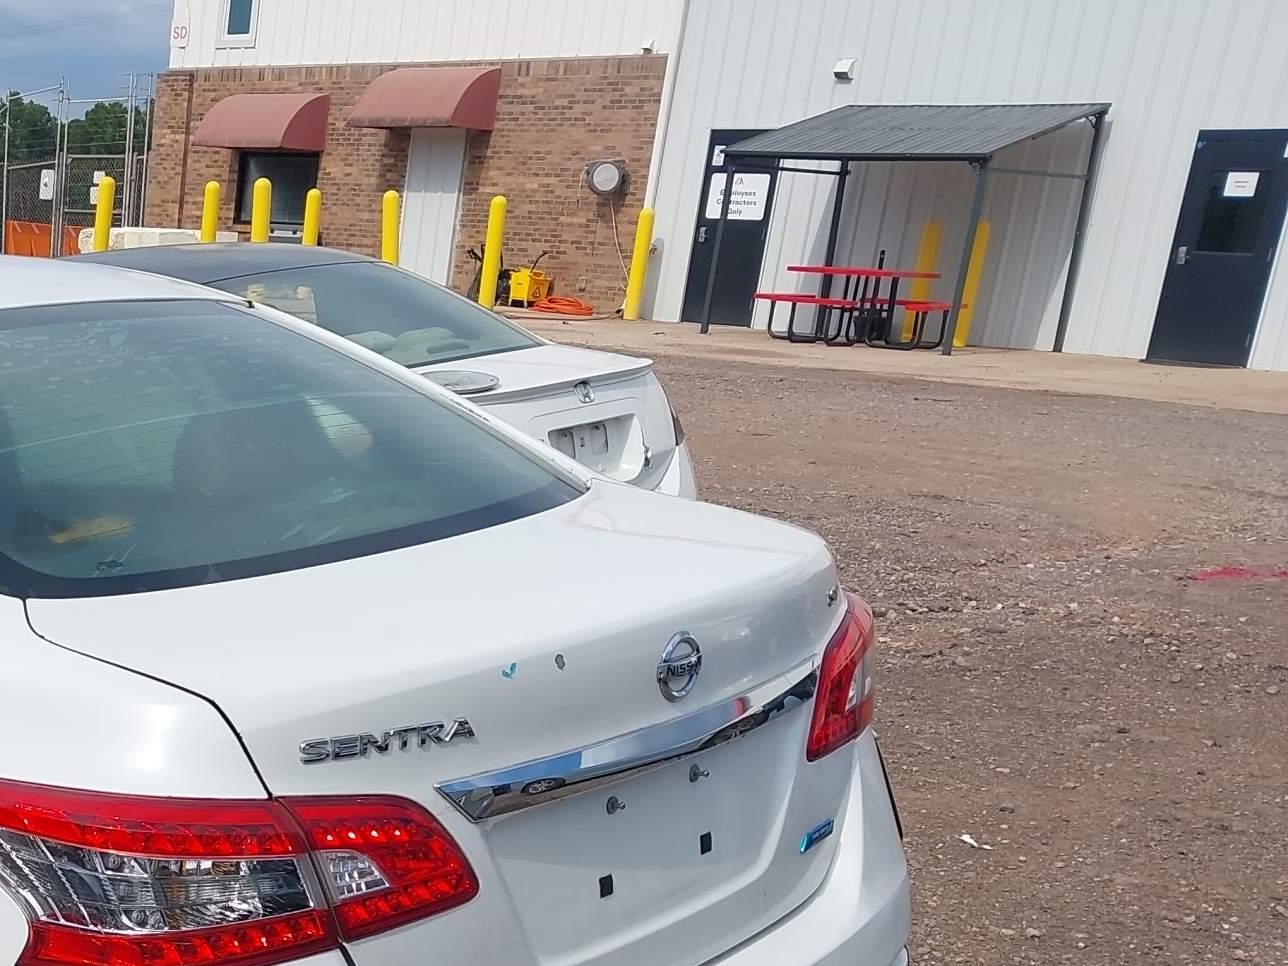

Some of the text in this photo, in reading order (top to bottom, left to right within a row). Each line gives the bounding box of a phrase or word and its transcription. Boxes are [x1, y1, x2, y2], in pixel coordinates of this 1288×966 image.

[173, 26, 187, 39] SD
[720, 189, 756, 197] Eloyees
[299, 717, 476, 765] SENTRA
